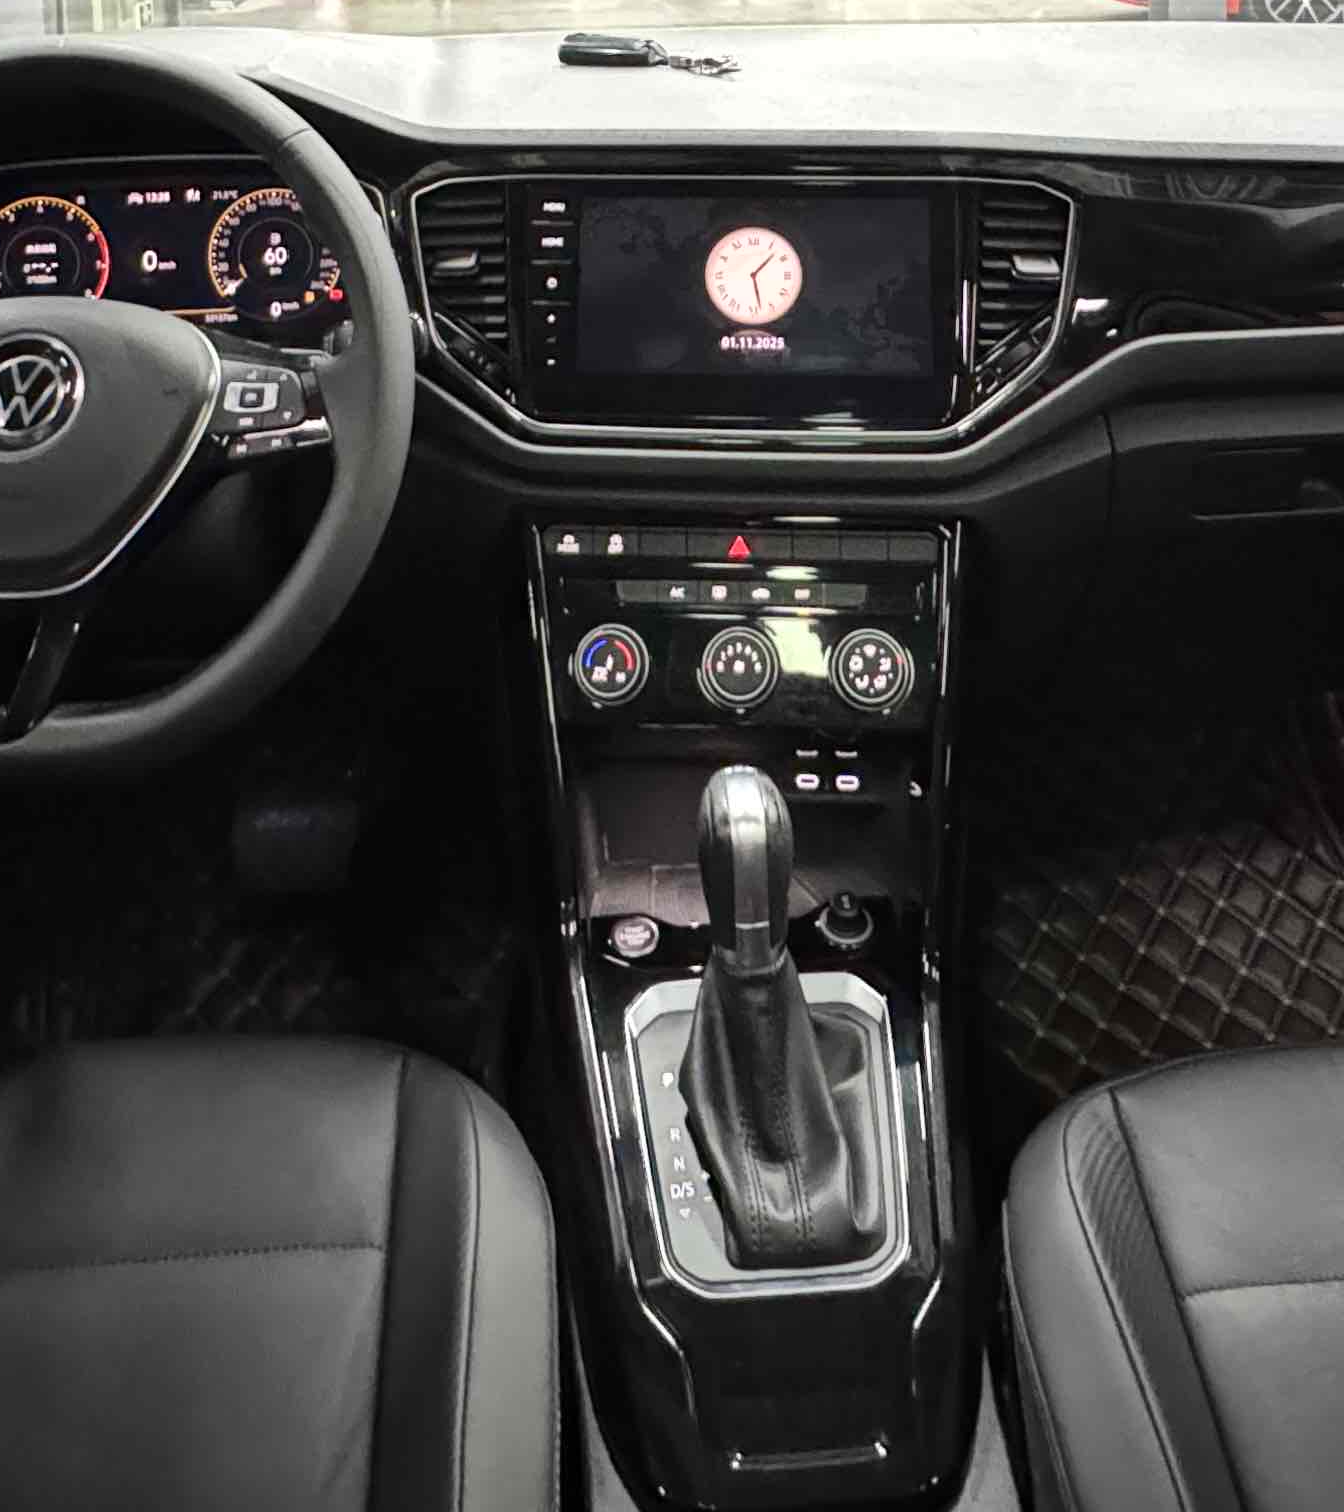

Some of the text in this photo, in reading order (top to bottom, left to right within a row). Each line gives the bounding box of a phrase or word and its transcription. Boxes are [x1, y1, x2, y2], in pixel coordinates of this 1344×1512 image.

[142, 251, 157, 272] 0
[263, 247, 287, 265] 60
[270, 302, 281, 318] 0
[720, 336, 785, 350] 01.11.2025
[674, 1155, 686, 1171] N
[670, 1181, 695, 1199] D/S
